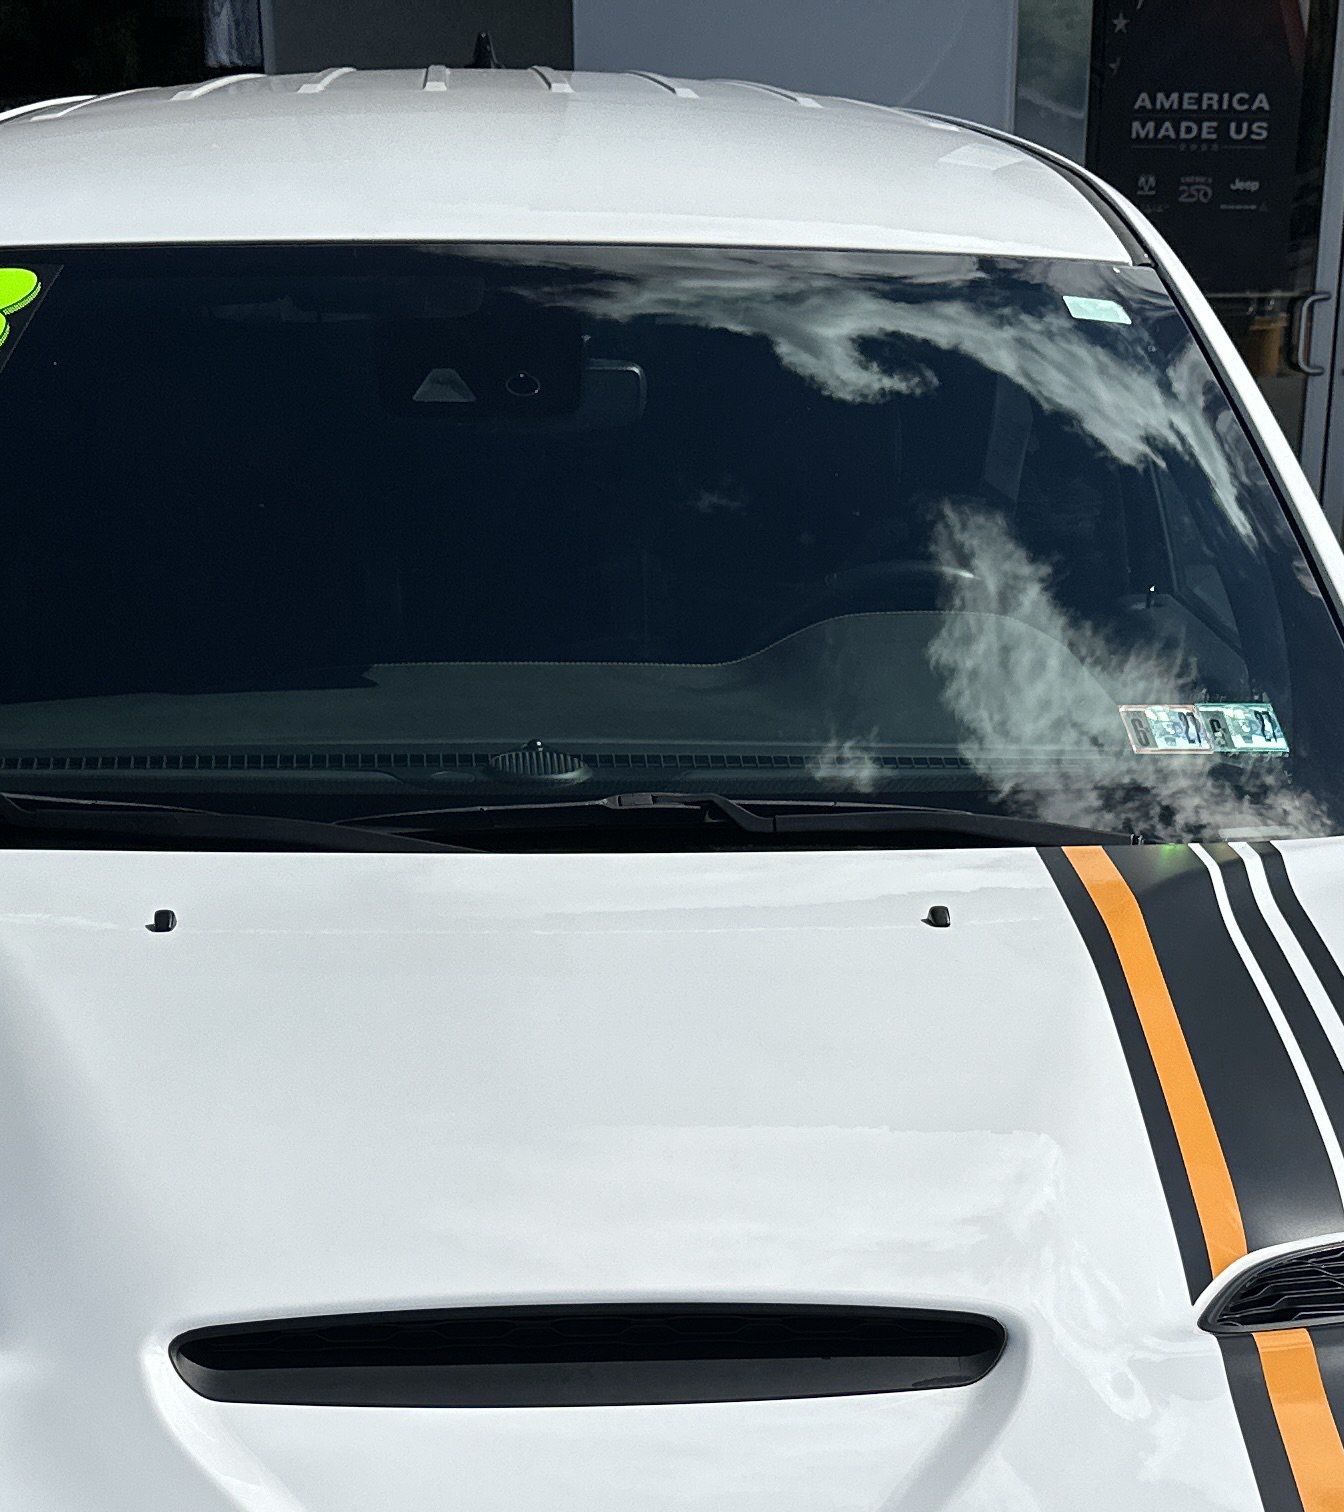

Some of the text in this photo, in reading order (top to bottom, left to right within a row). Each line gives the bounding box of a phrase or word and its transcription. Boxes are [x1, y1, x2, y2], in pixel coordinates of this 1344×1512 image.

[1134, 92, 1271, 111] AMERICA
[1131, 121, 1269, 140] MADE US
[1230, 178, 1260, 192] Jeep
[1131, 718, 1150, 747] 6
